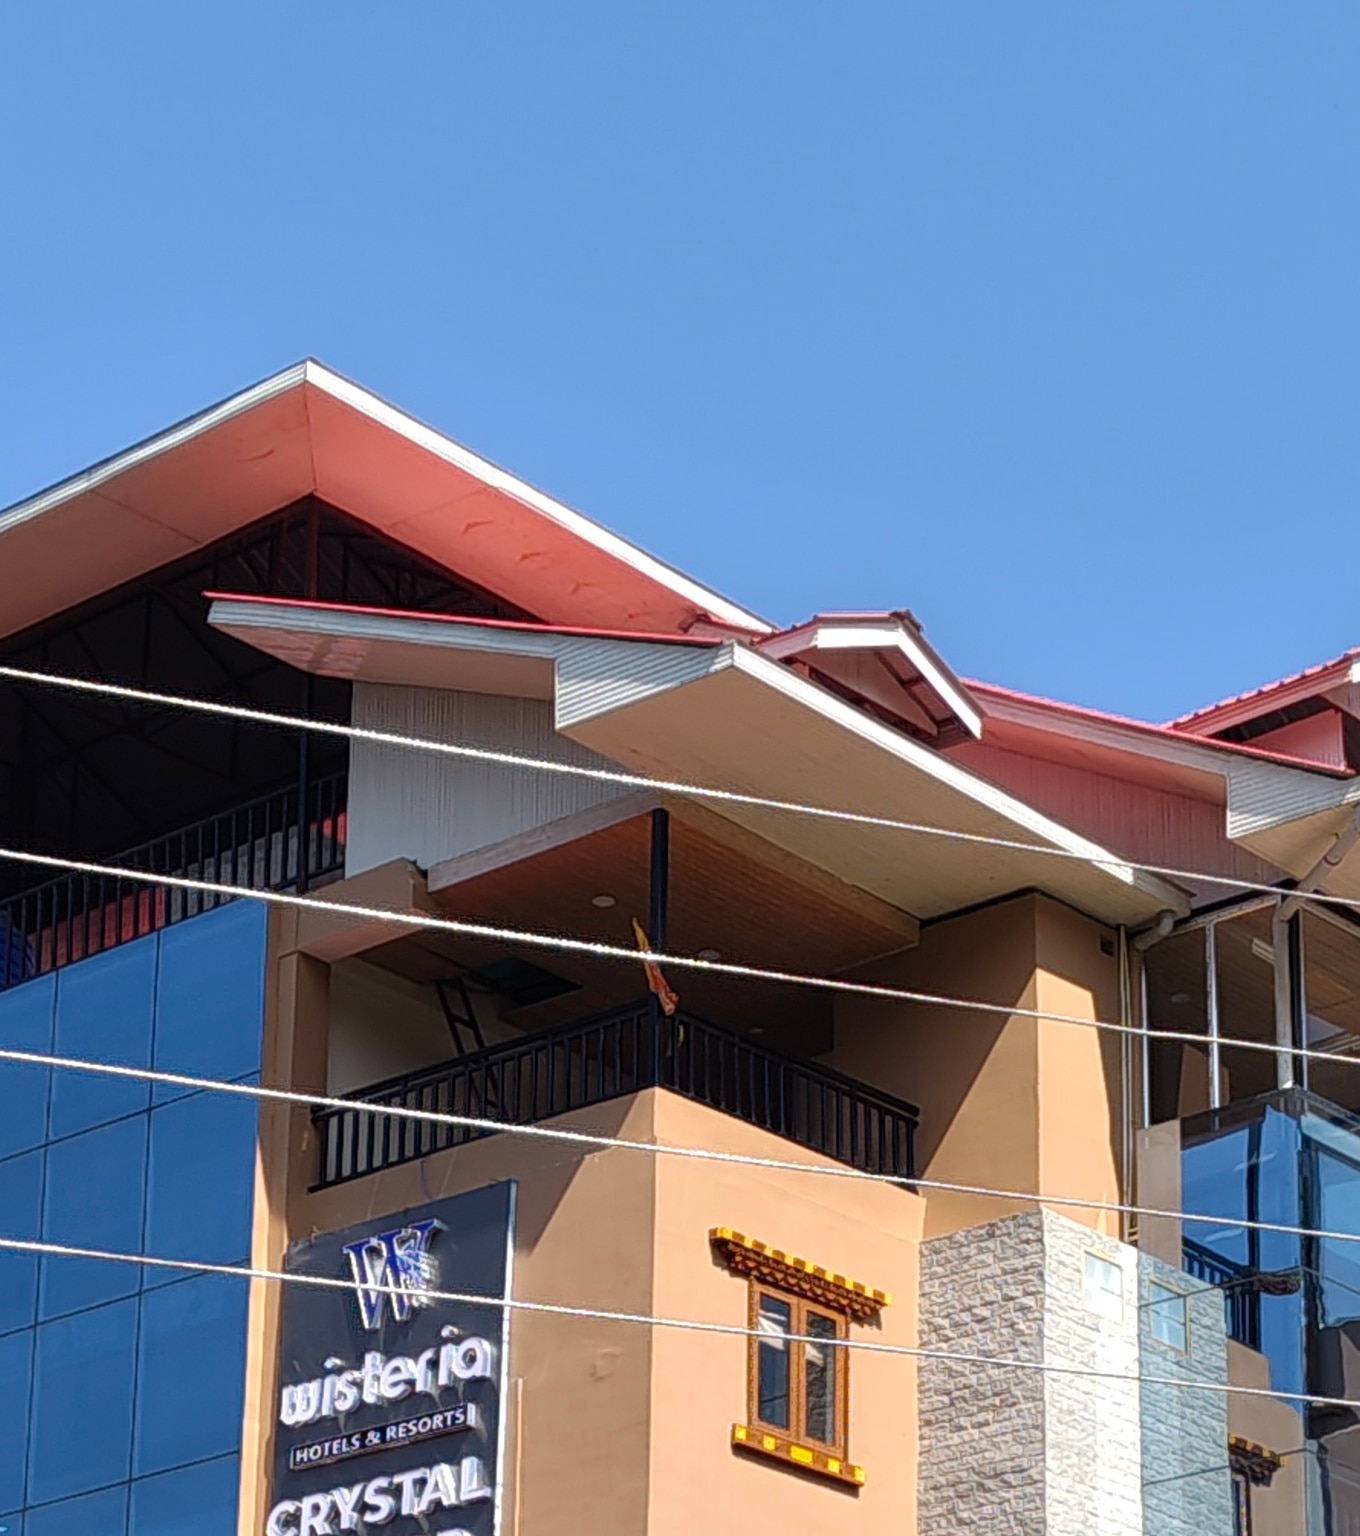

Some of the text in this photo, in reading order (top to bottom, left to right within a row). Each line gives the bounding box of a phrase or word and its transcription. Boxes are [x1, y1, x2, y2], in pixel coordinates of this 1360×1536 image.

[295, 1407, 467, 1465] HOTELS & RESORTS
